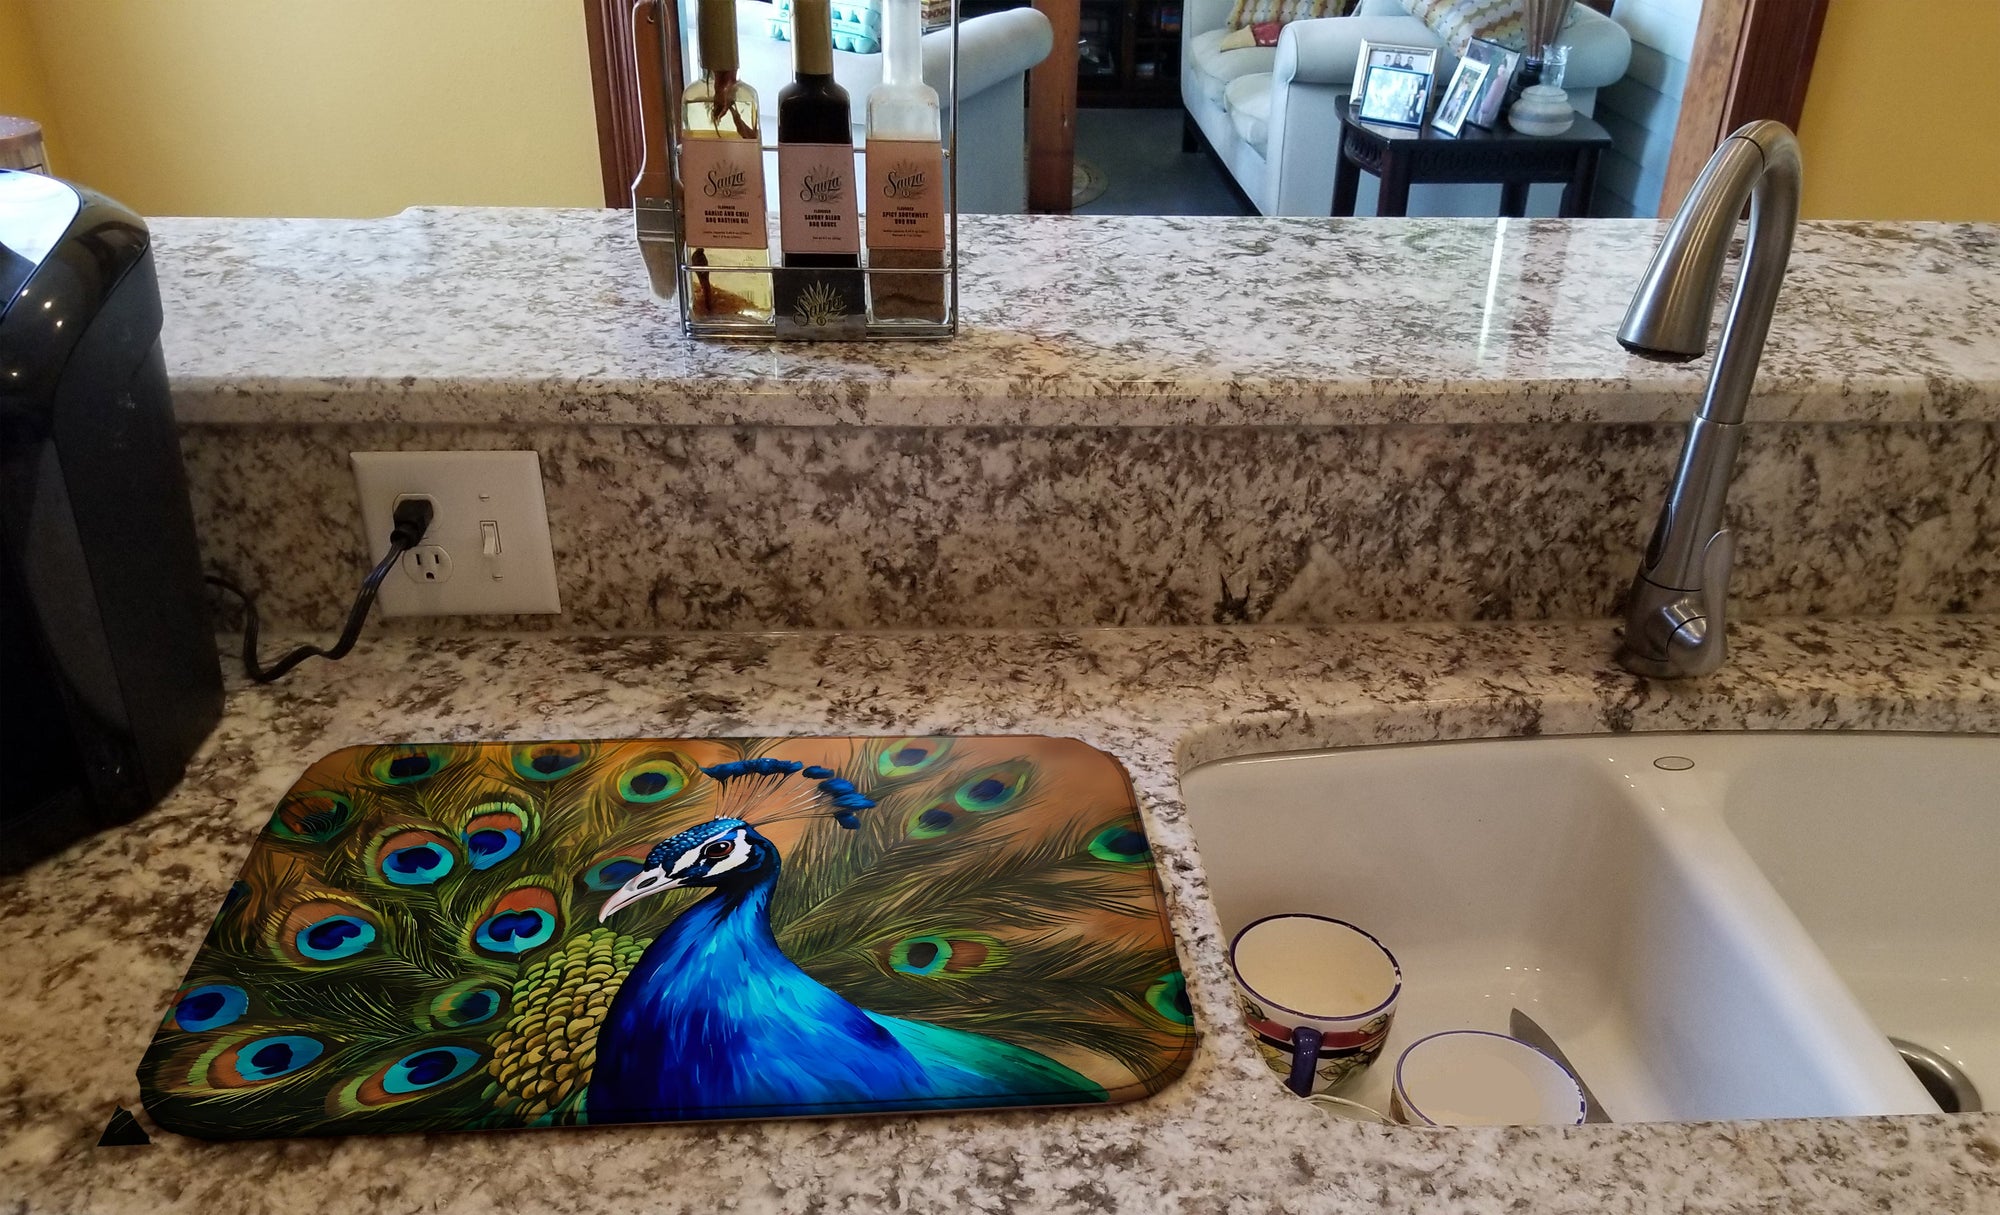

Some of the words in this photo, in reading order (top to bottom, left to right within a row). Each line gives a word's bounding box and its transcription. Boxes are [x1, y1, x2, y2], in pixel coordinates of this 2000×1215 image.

[703, 170, 746, 197] Sauza
[800, 175, 842, 202] Sauza
[883, 170, 926, 198] Sauza
